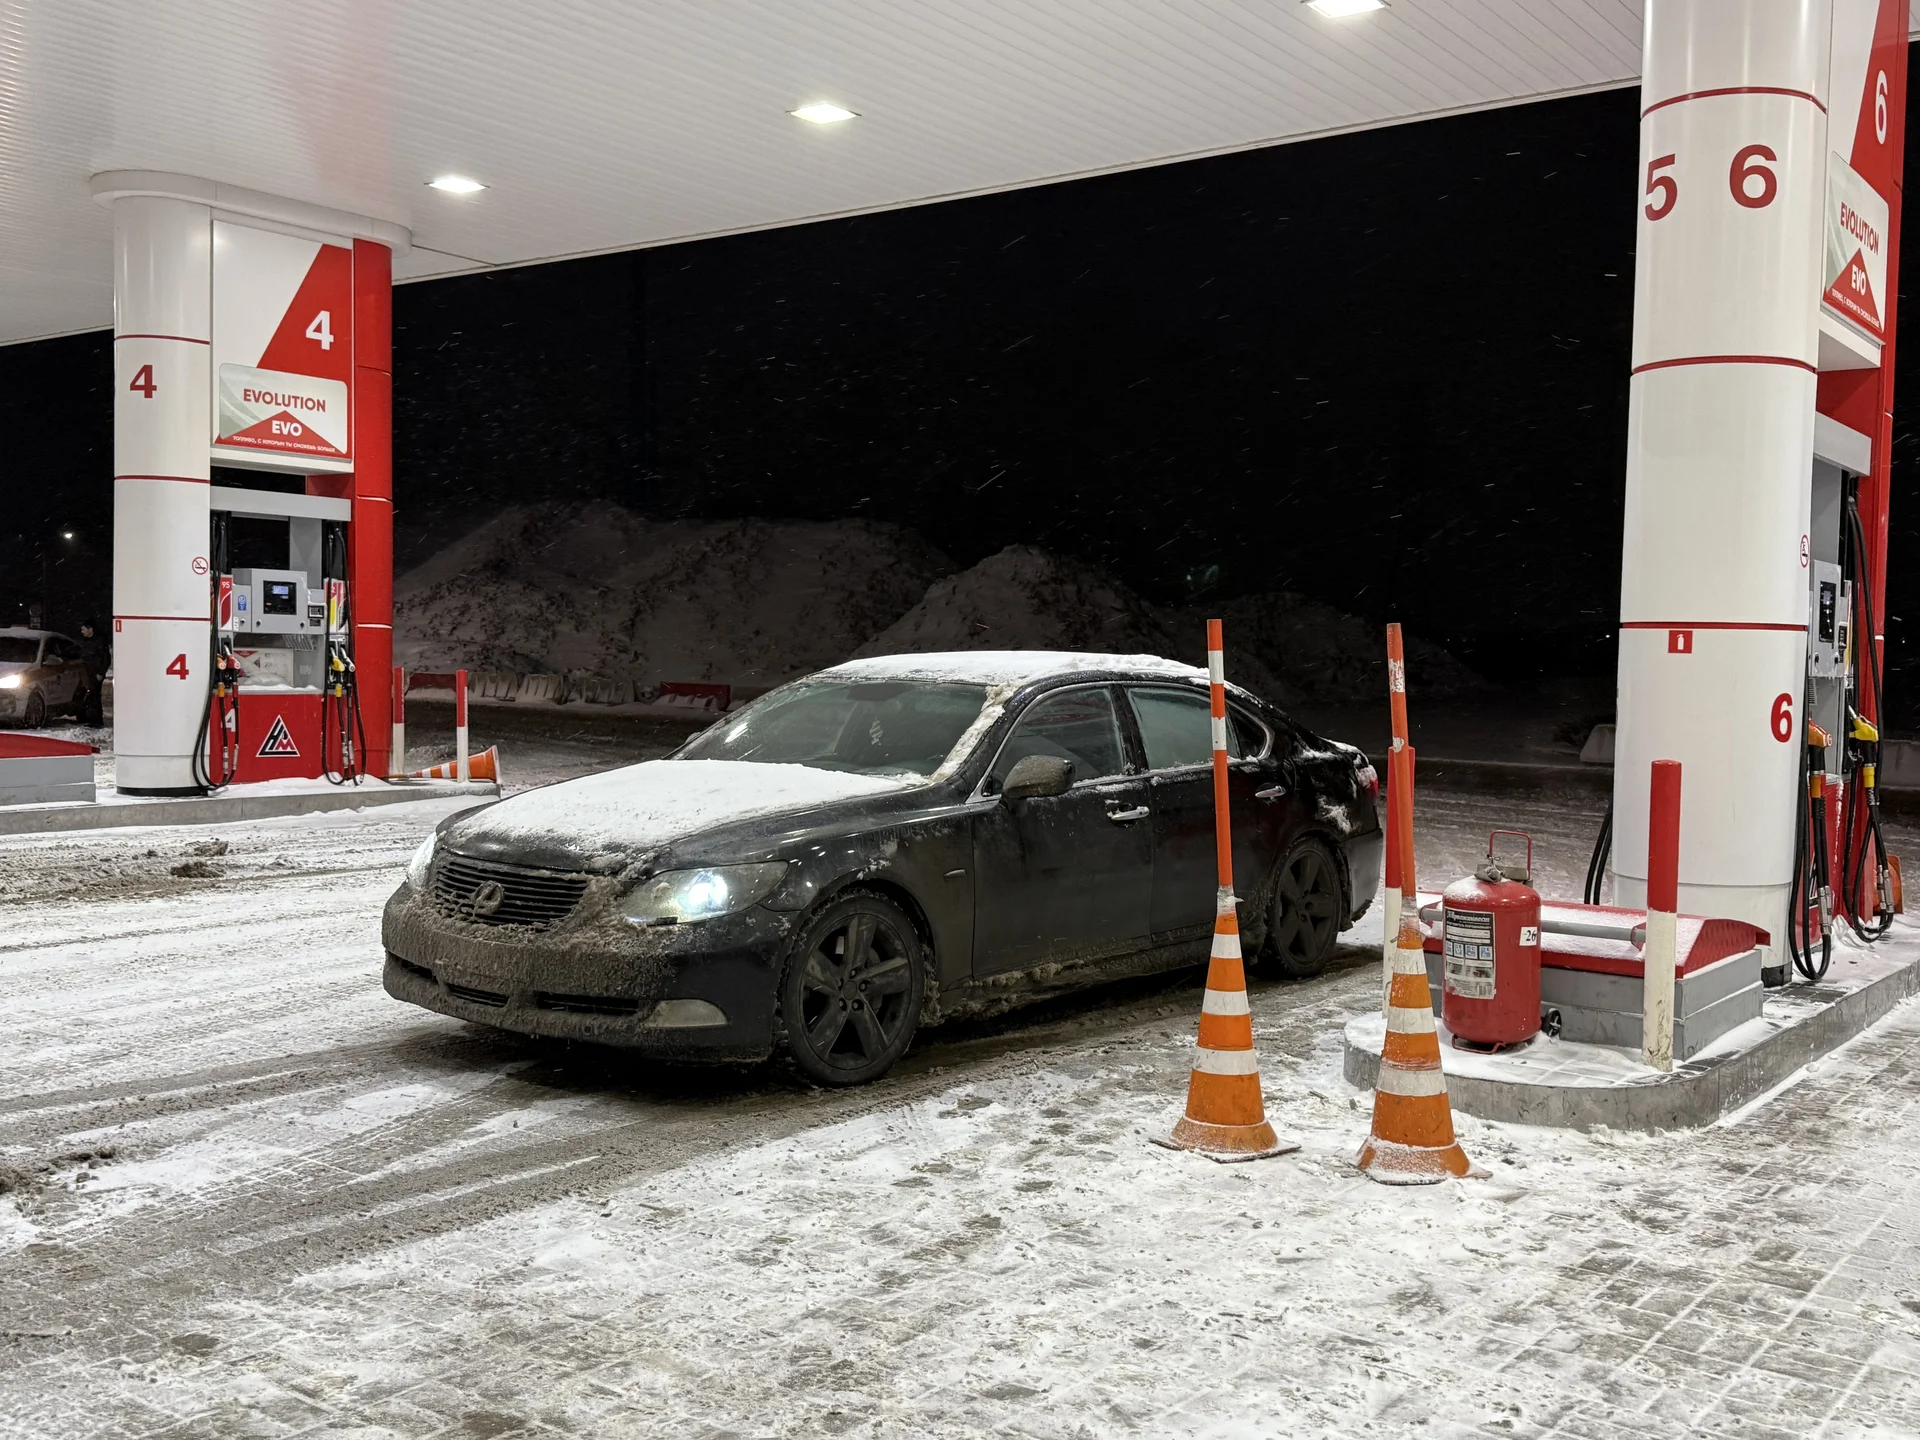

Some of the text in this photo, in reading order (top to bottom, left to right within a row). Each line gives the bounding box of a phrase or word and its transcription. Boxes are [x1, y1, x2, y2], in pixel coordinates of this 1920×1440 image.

[1875, 69, 1888, 145] 6
[1644, 144, 1778, 222] 5 6
[1840, 201, 1879, 256] EVOLUTION
[1851, 263, 1866, 296] EVO
[305, 310, 334, 350] 4
[130, 364, 157, 399] 4
[243, 388, 326, 413] EVOLUTION
[271, 420, 303, 437] EVO
[221, 581, 231, 589] 95
[166, 653, 189, 680] 4
[1770, 692, 1793, 743] 6
